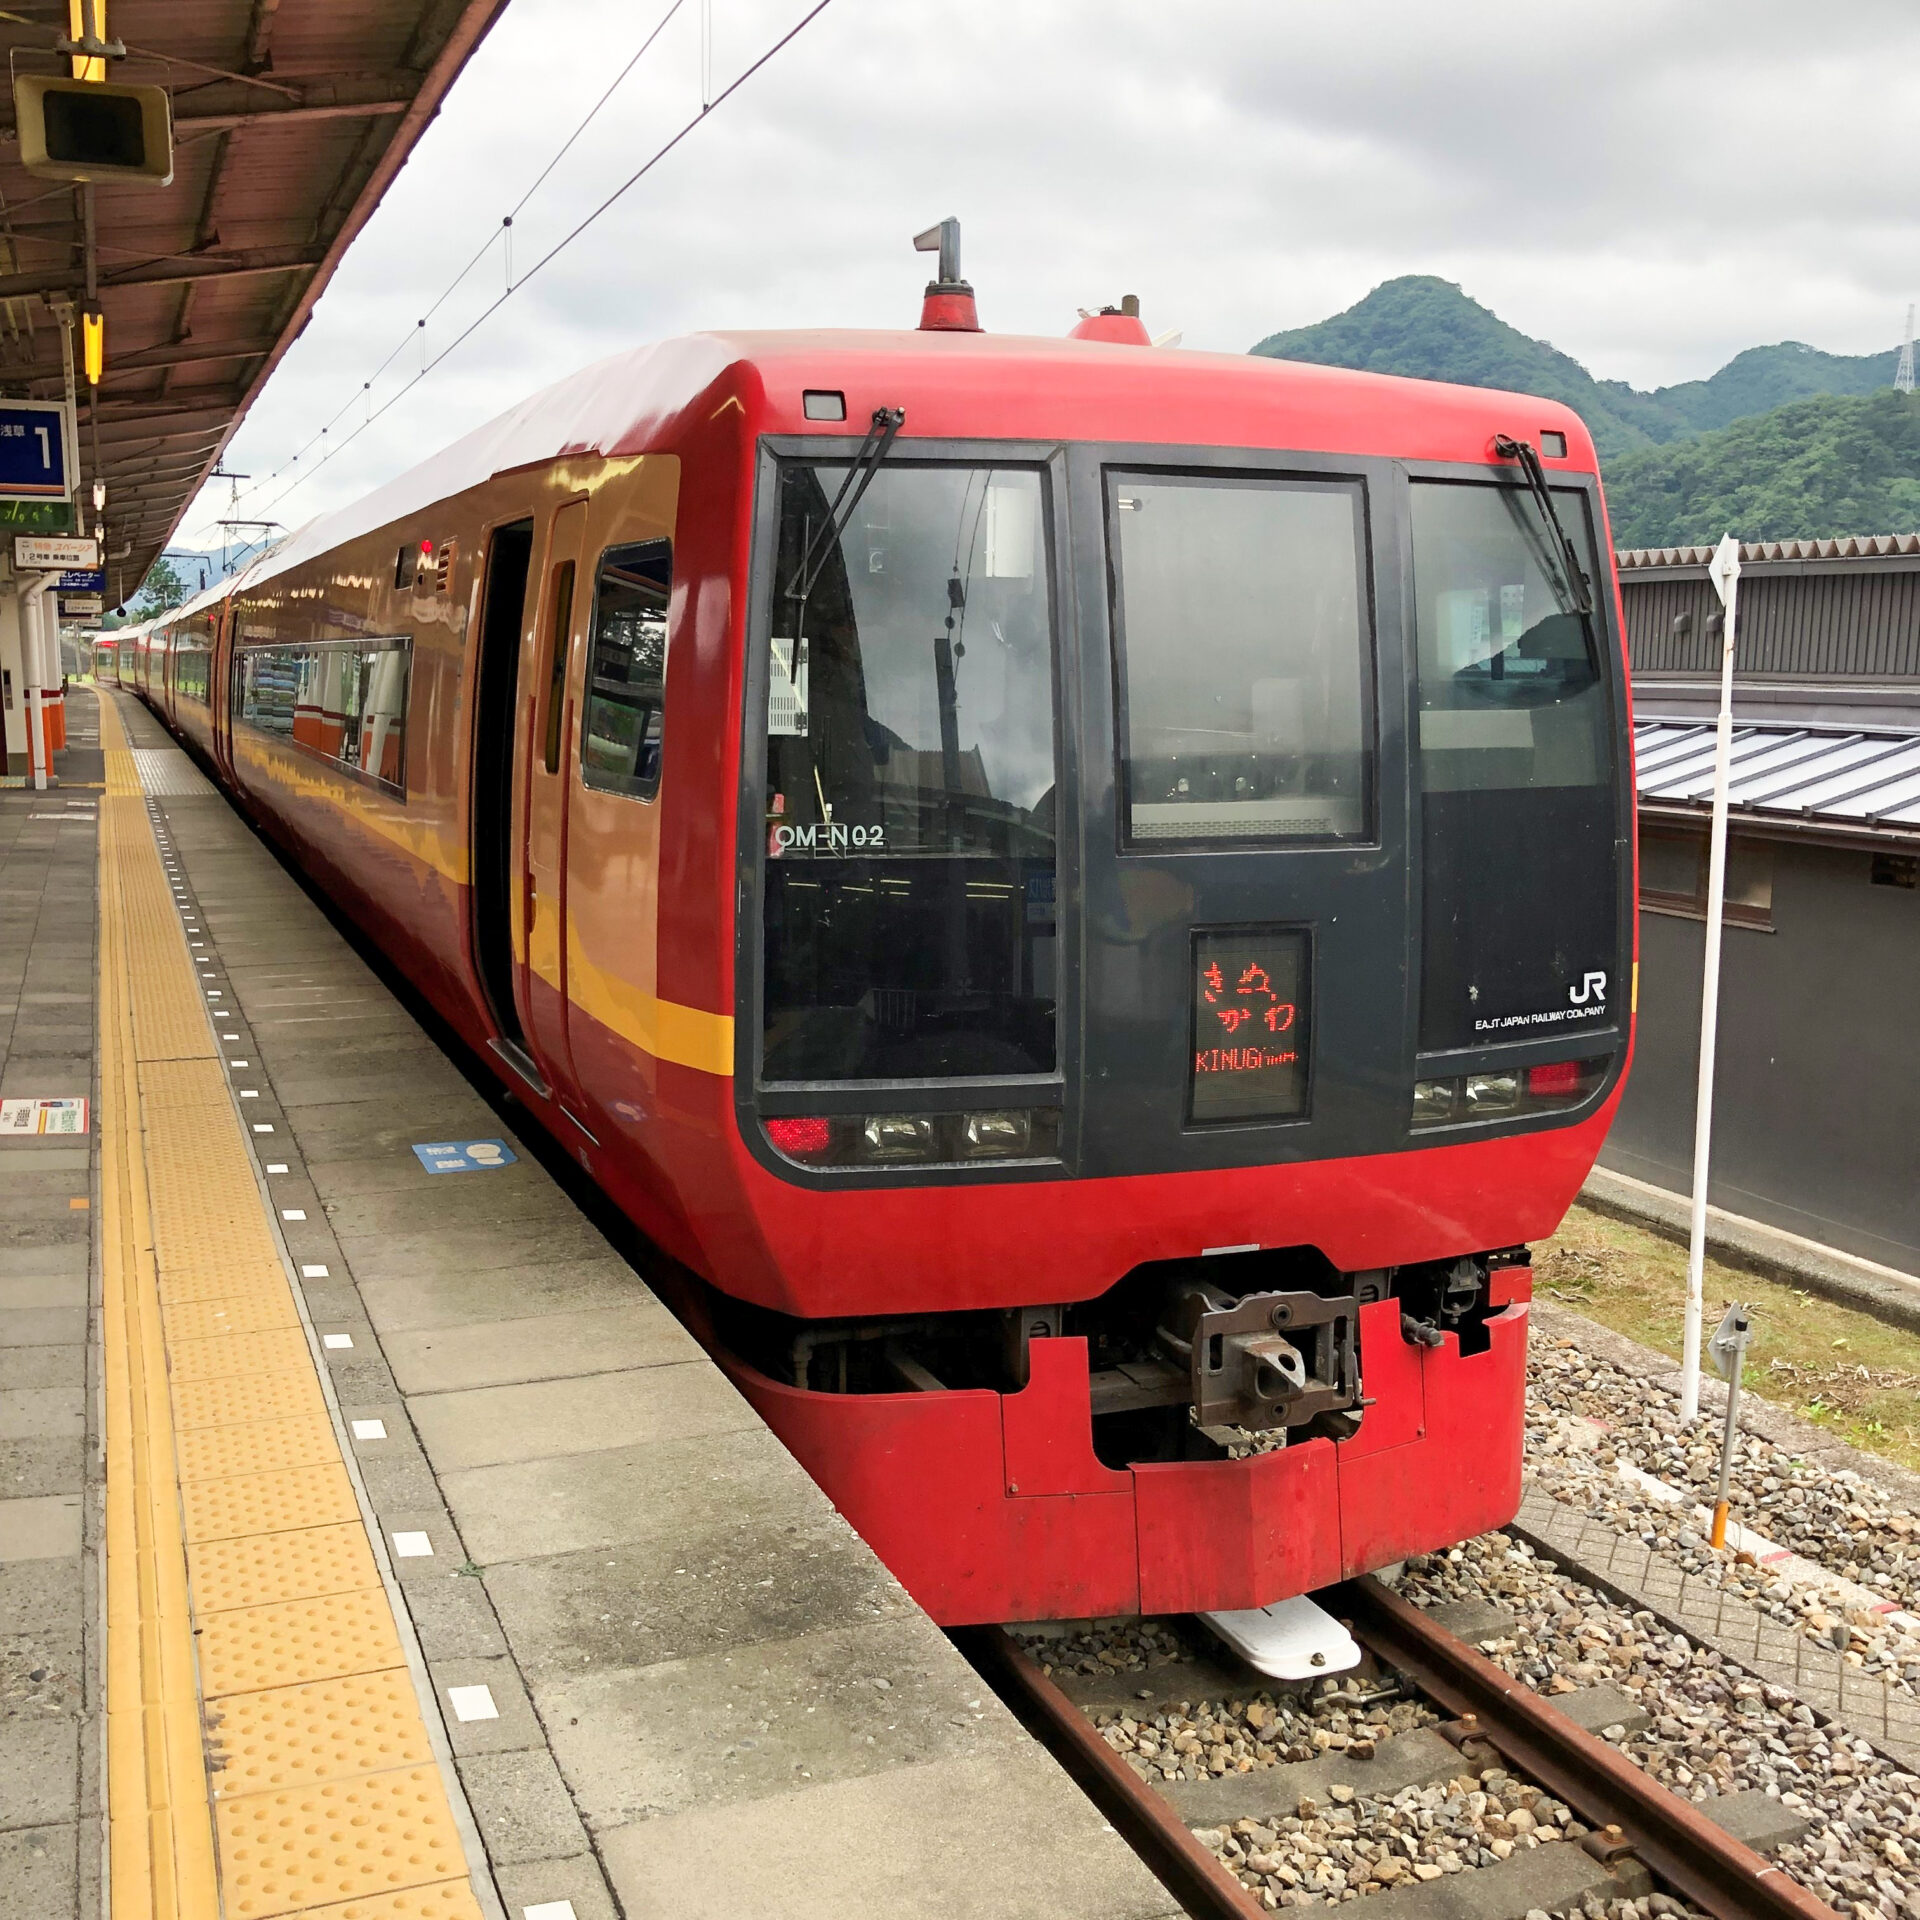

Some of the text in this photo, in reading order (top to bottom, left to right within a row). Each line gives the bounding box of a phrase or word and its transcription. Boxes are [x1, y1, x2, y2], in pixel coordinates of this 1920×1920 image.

[1, 424, 51, 469] 浅草 1
[1569, 970, 1607, 1004] JR
[1475, 1005, 1606, 1031] EAST JAPAN RAILWAY COMPANY
